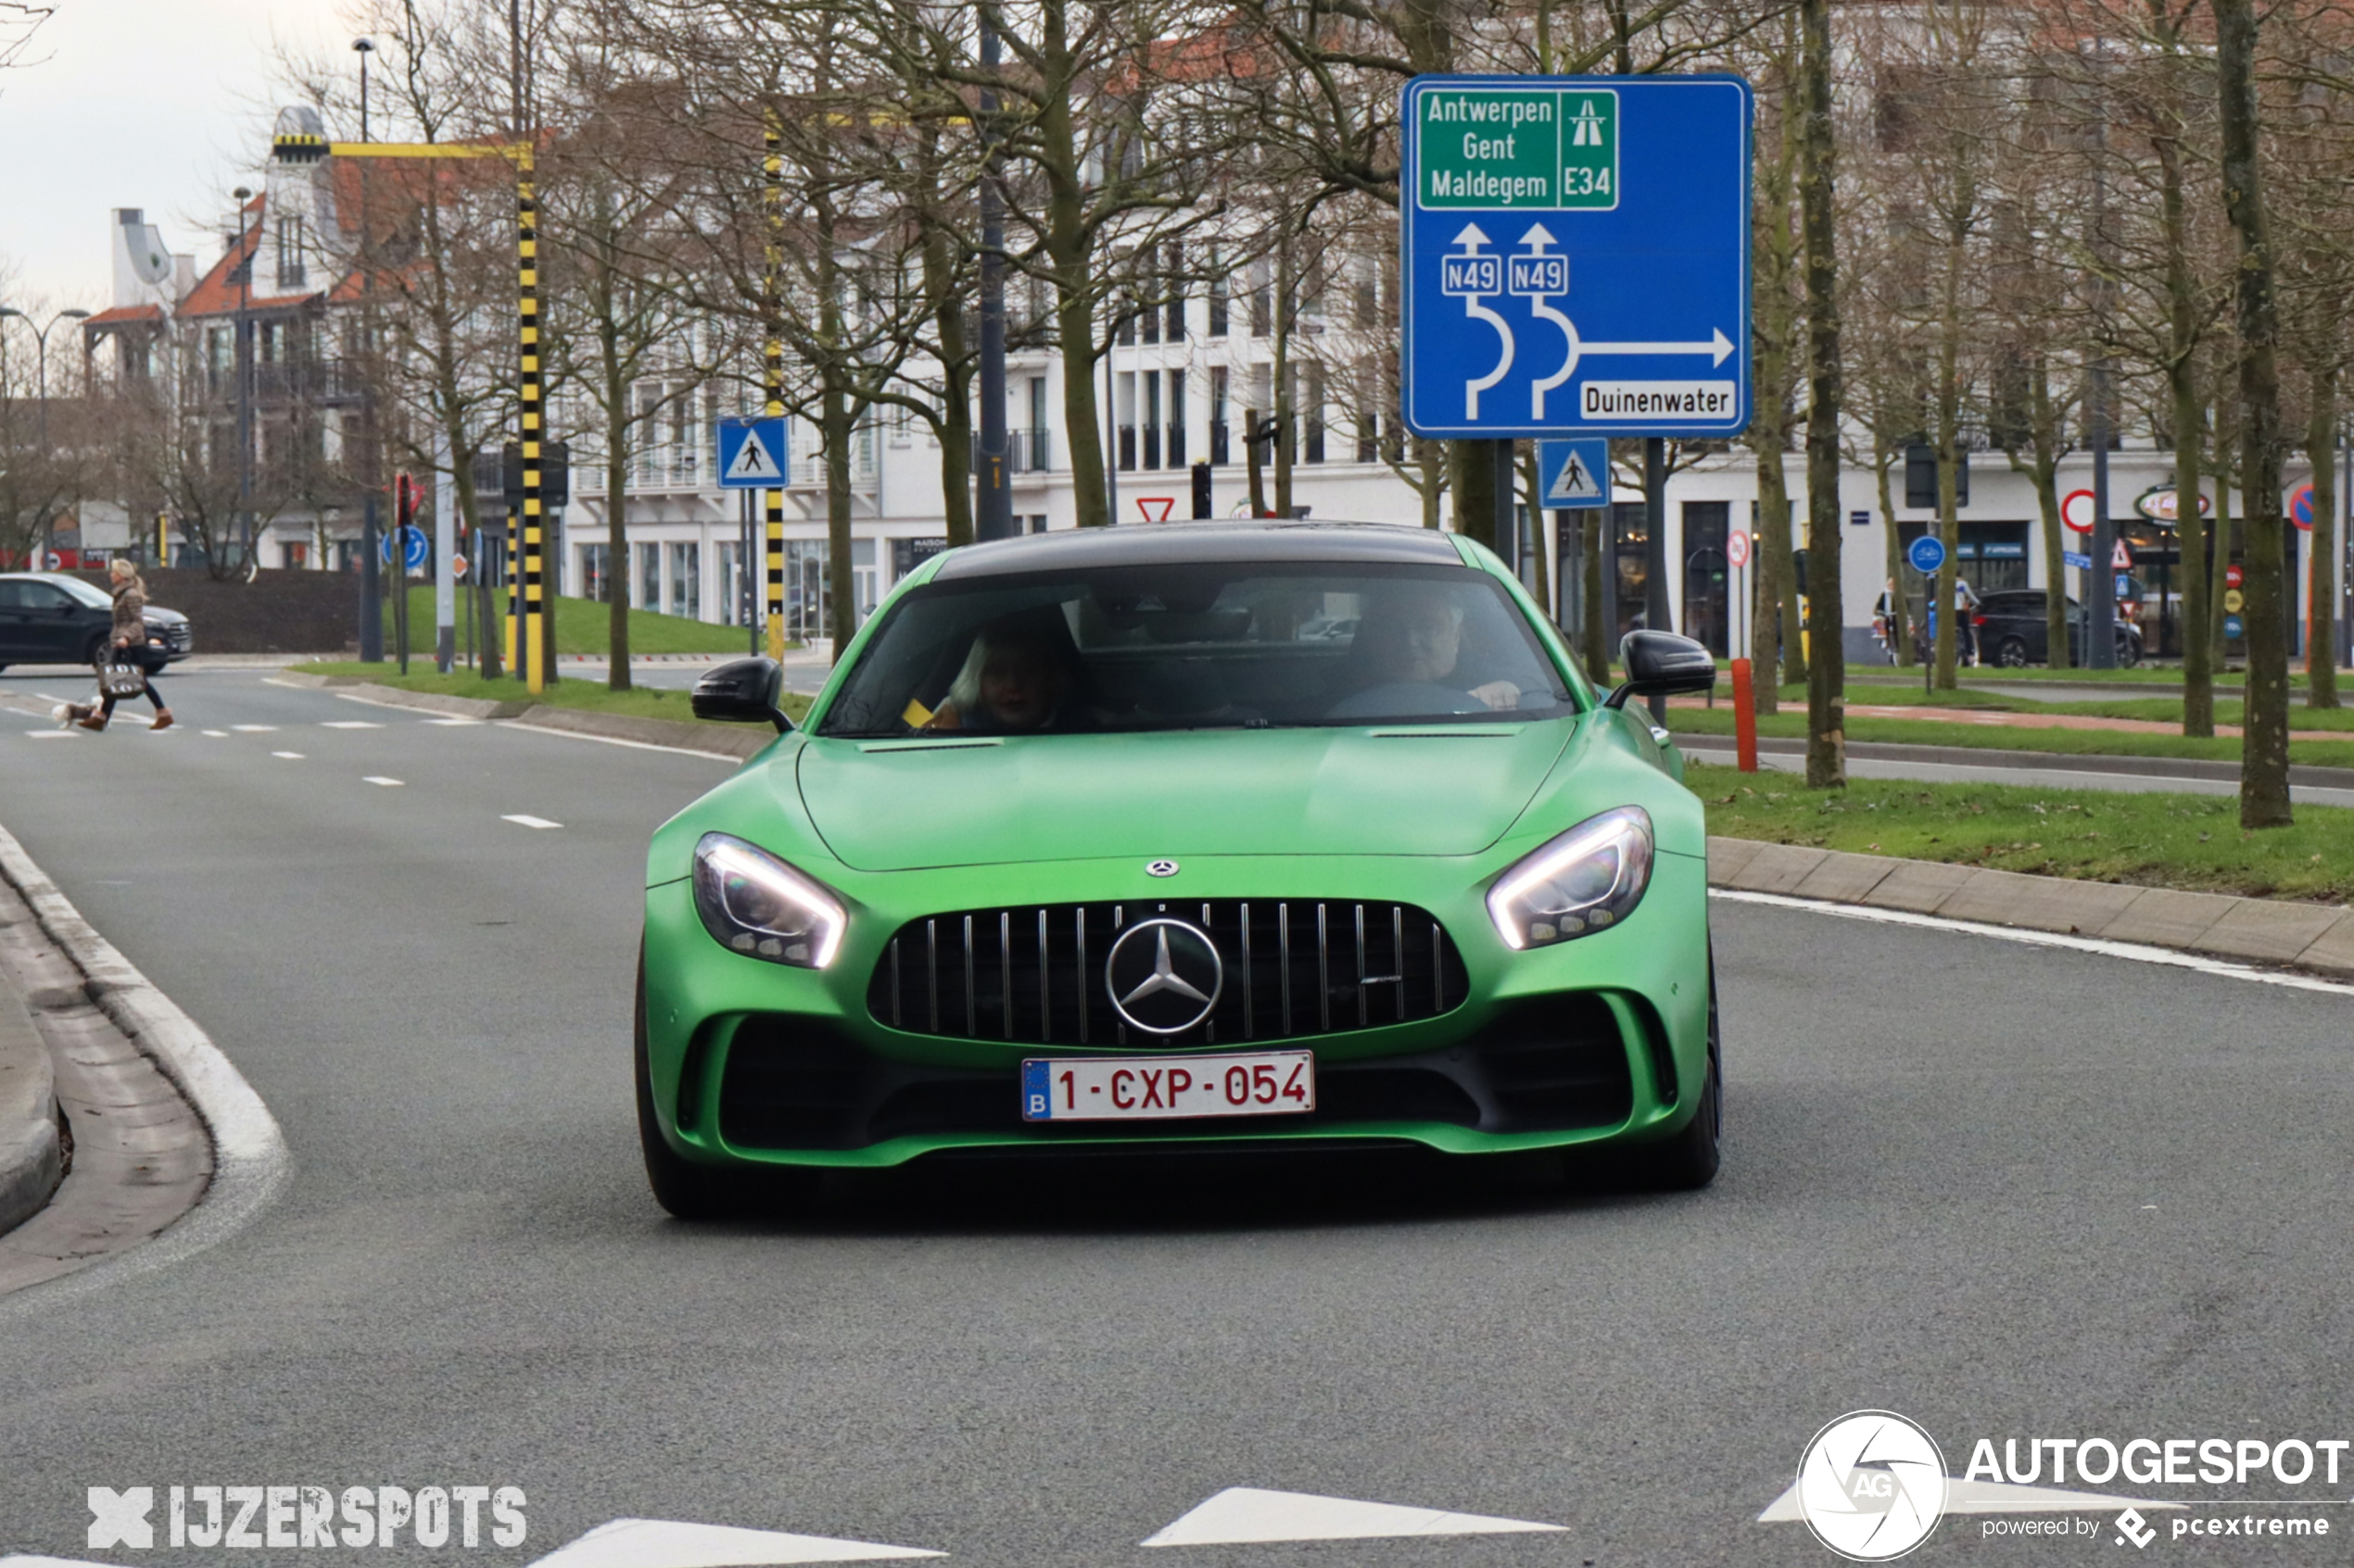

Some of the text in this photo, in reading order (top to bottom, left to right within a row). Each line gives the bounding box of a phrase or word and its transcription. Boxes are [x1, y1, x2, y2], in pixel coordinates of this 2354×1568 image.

[1427, 95, 1552, 128] Antwerpen
[1462, 133, 1515, 159] Gent
[1431, 171, 1547, 204] Maldegem
[1563, 167, 1611, 196] E34
[1448, 261, 1496, 289] N49
[1514, 261, 1562, 289] N49
[1586, 387, 1728, 413] Duinenwater
[1059, 1063, 1306, 1109] 1-CXP-054
[1030, 1094, 1046, 1113] B
